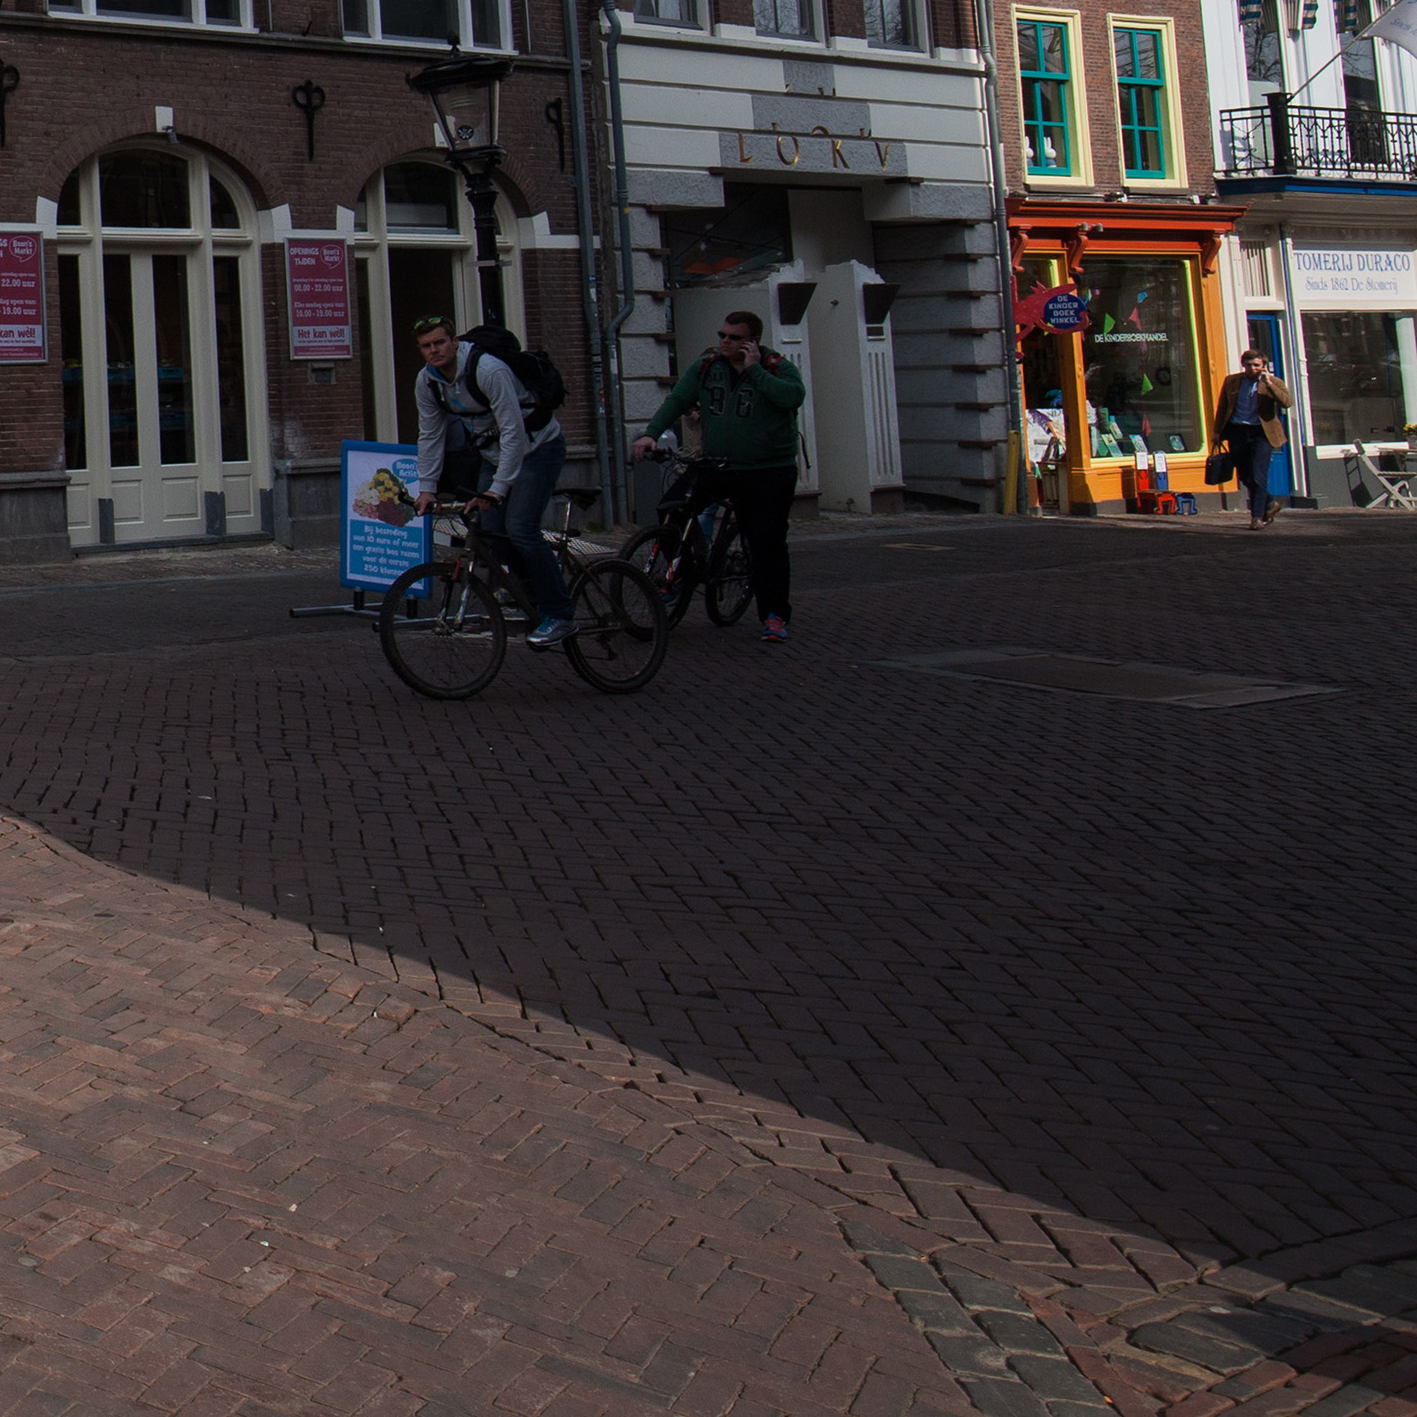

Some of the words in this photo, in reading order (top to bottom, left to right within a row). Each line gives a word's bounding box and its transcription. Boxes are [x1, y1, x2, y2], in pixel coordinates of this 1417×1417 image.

[1293, 253, 1353, 271] TOMERIJ
[1356, 253, 1410, 271] DURACO
[1, 279, 21, 287] 22.00
[1306, 277, 1328, 291] Sinds
[1351, 278, 1364, 291] De
[3, 307, 22, 315] 19.00
[1095, 334, 1103, 342] DE
[396, 462, 418, 470] Boon'
[367, 535, 374, 543] 10
[393, 538, 400, 547] of
[366, 545, 385, 554] gratis
[364, 564, 378, 572] 250
